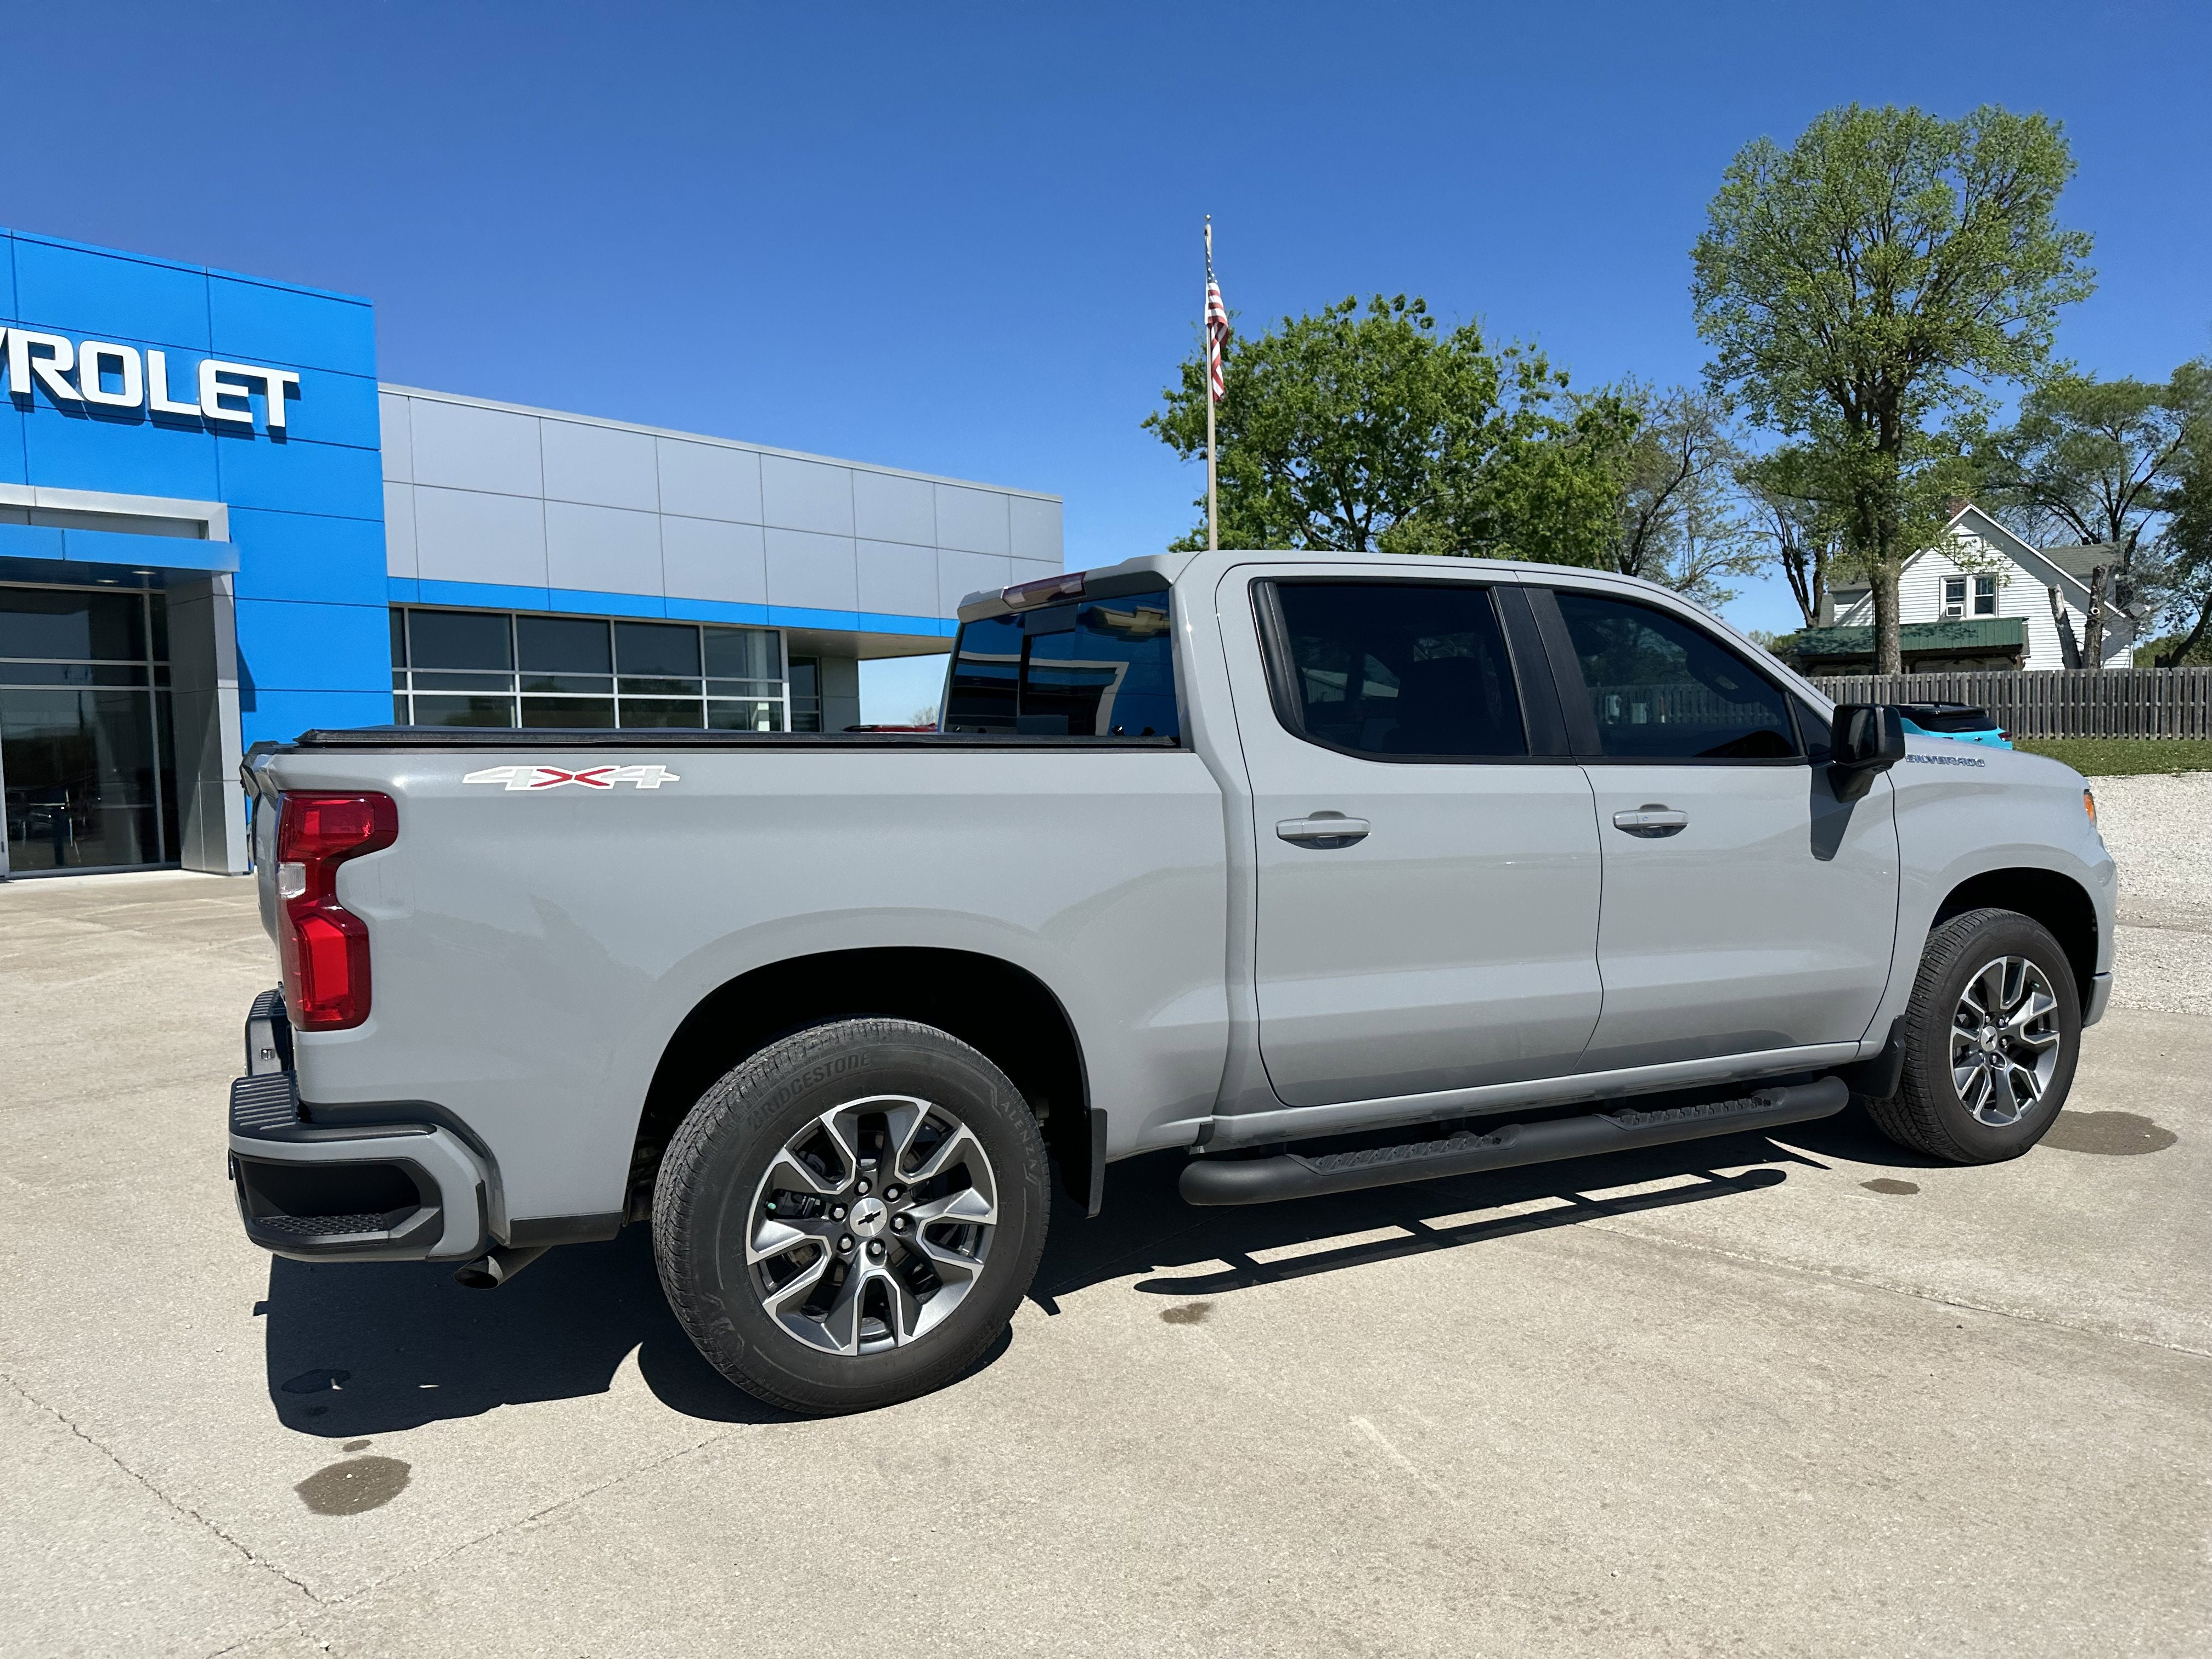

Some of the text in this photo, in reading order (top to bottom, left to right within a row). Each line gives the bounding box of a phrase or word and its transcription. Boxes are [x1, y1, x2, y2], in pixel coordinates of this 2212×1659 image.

[0, 326, 300, 427] ROLET
[1905, 754, 1985, 767] SILVERADO
[746, 1049, 871, 1131] BRIDGESTONE
[1001, 1101, 1038, 1170] ALENZA
